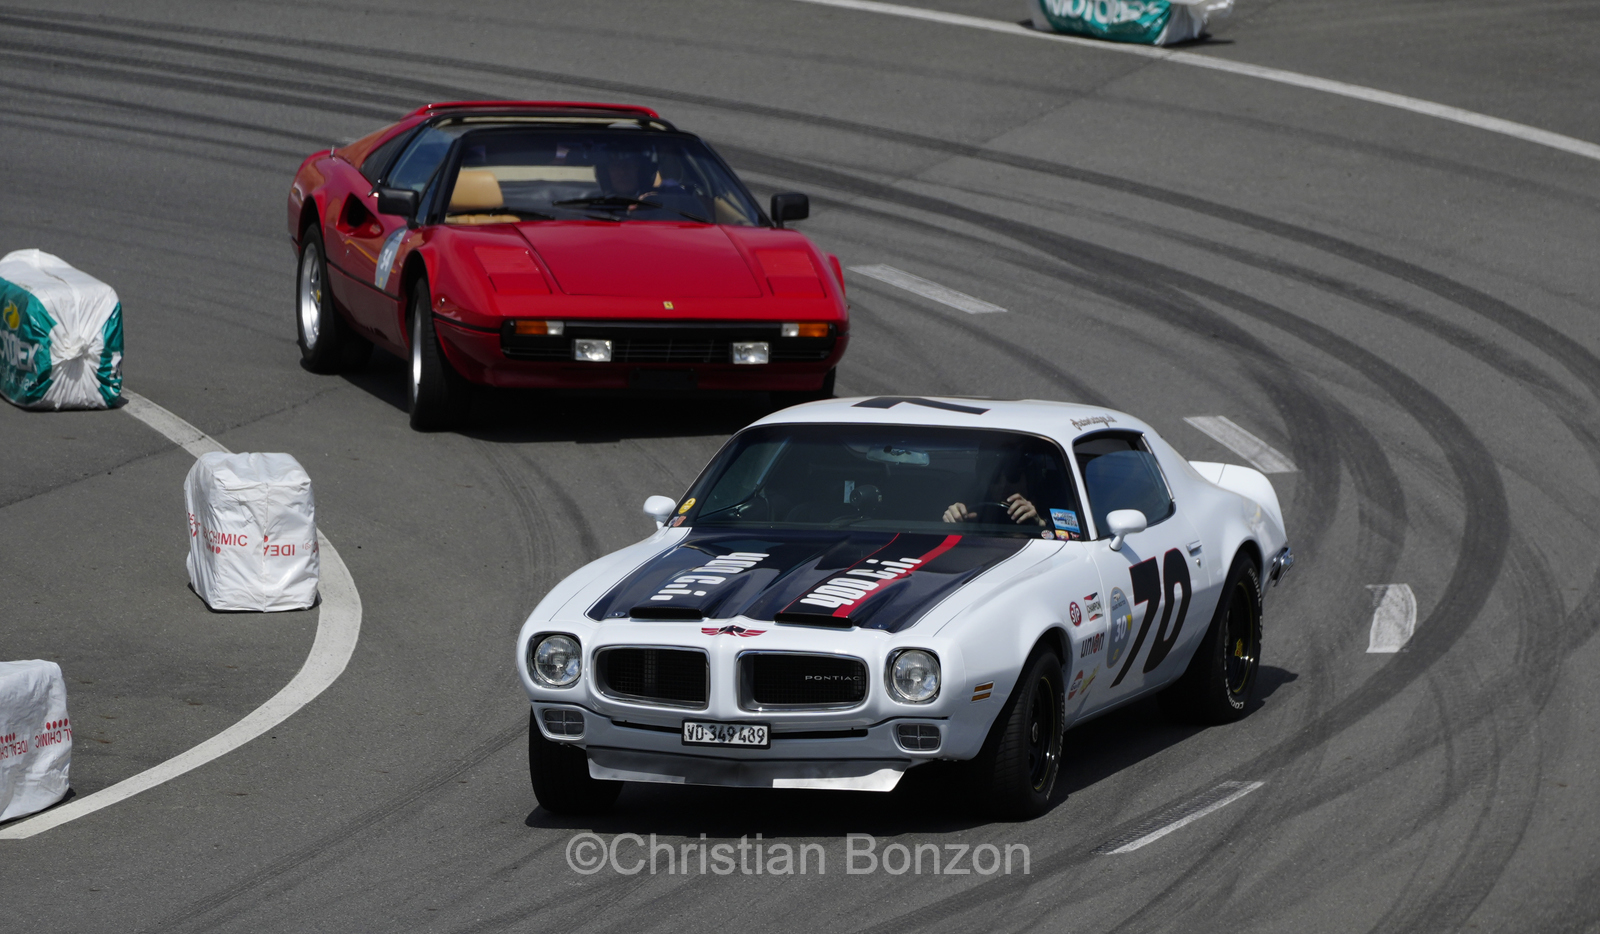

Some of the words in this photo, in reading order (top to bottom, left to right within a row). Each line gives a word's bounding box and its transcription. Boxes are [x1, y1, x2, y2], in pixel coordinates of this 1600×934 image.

[1071, 603, 1080, 623] STP
[1109, 547, 1192, 688] 70
[1114, 615, 1127, 643] 30
